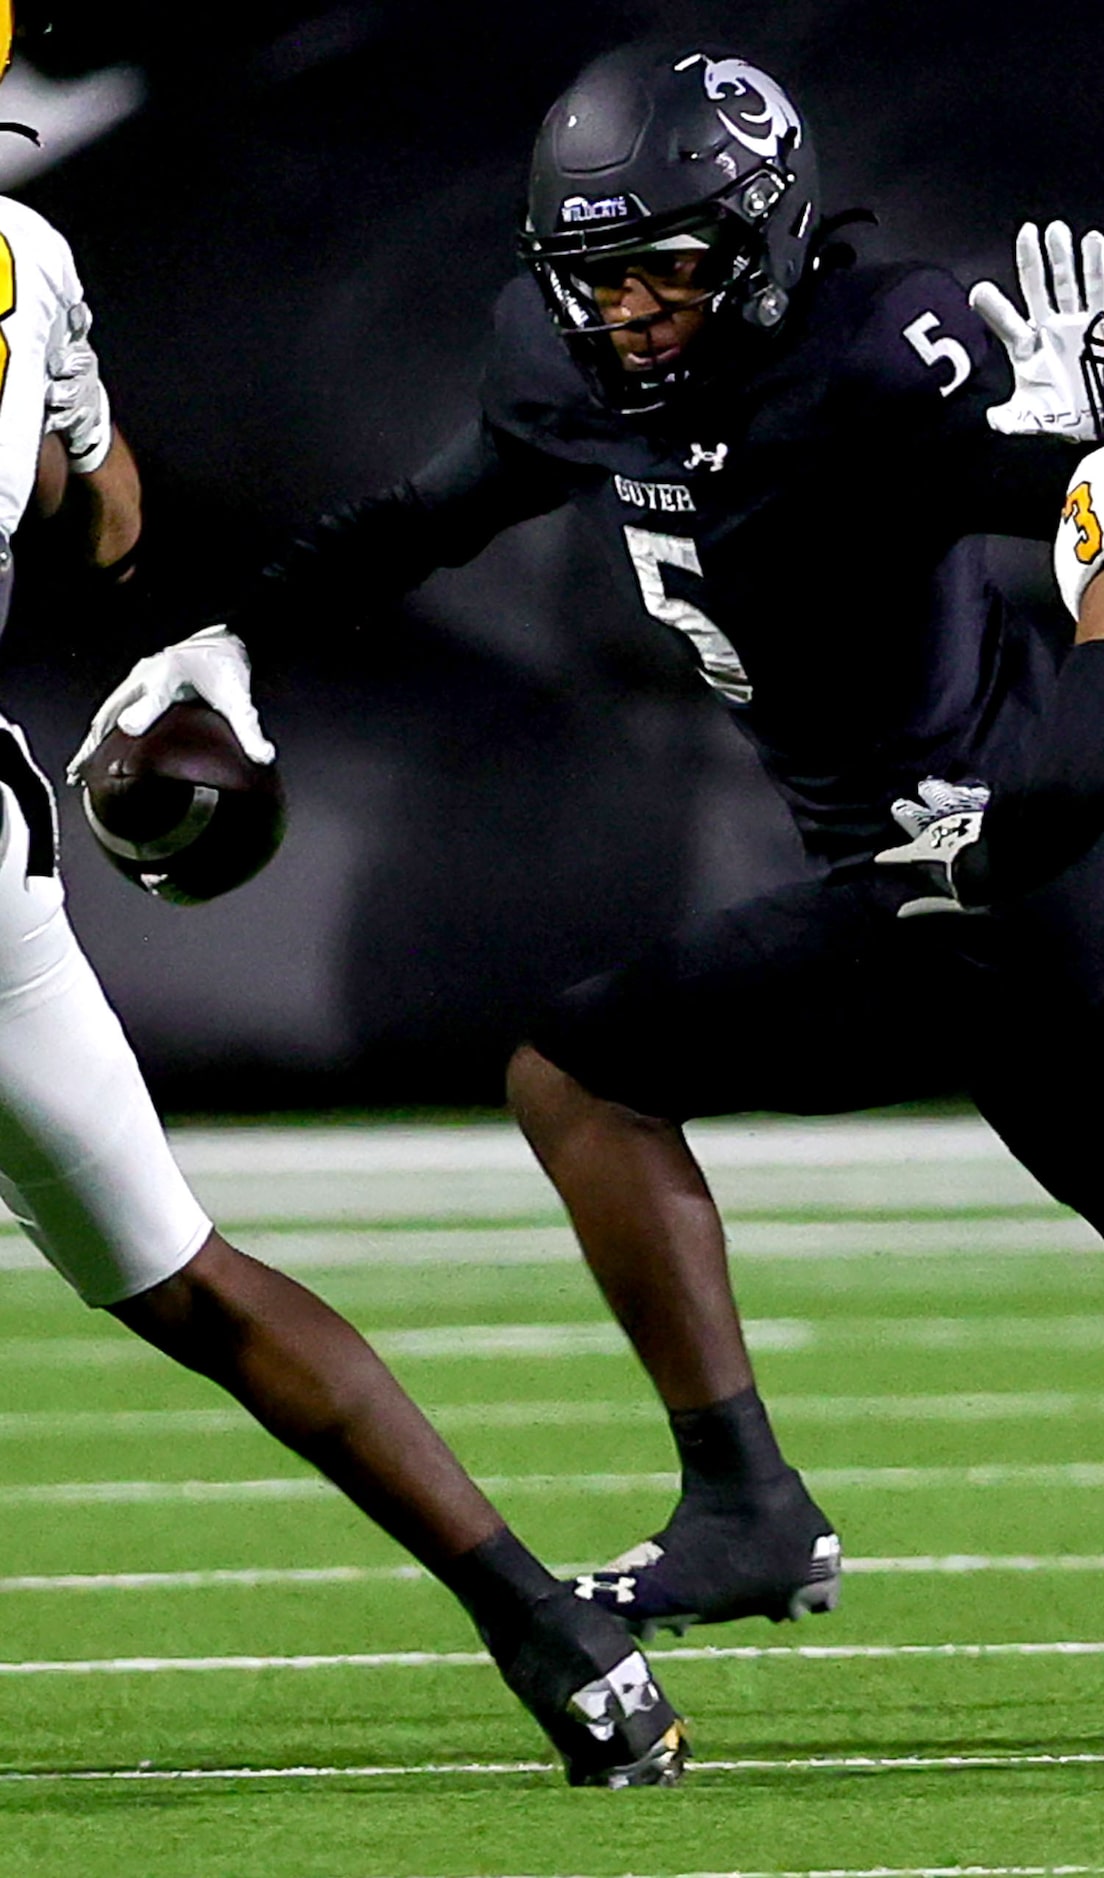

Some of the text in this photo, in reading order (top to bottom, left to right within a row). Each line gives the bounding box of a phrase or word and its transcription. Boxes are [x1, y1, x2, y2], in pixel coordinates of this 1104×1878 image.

[561, 195, 628, 223] WILDCATS
[902, 311, 972, 398] 5
[613, 473, 697, 512] GUYER
[1061, 480, 1104, 565] 3
[622, 524, 754, 703] 5
